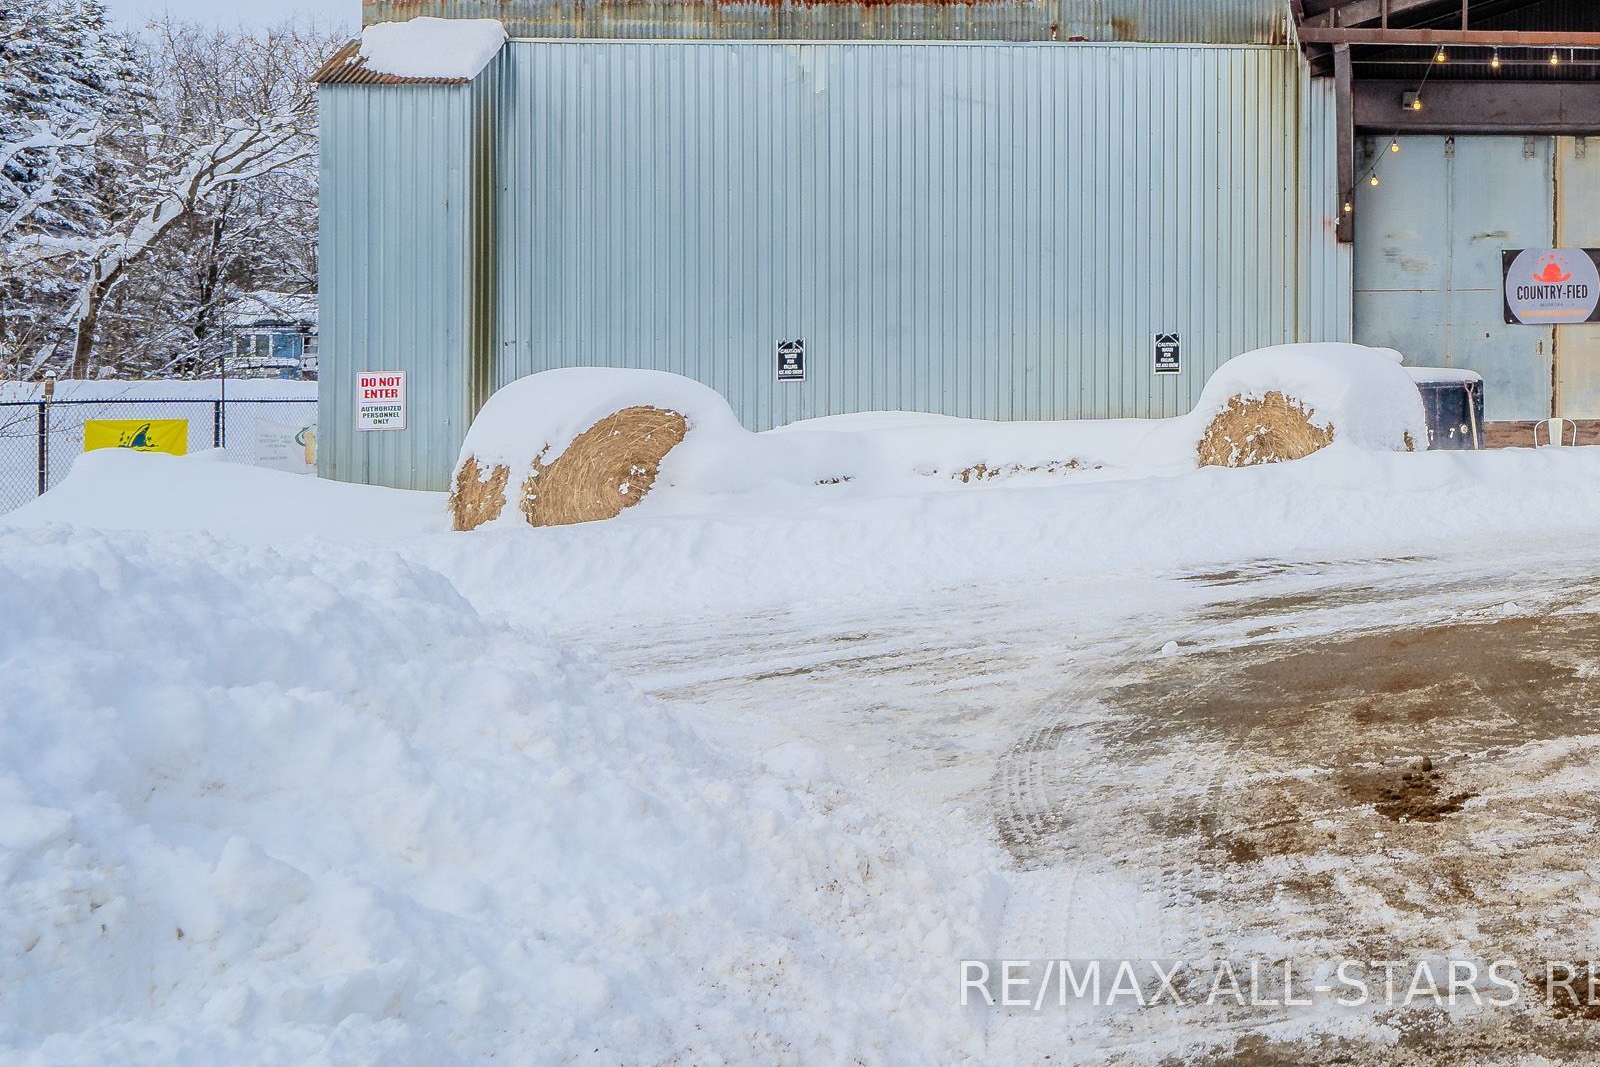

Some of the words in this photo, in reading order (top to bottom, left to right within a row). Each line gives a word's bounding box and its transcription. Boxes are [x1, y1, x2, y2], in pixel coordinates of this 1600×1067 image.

[1517, 284, 1588, 301] COUNTRY-FIED
[361, 377, 376, 387] DO
[379, 376, 401, 387] NOT
[364, 388, 398, 399] ENTER
